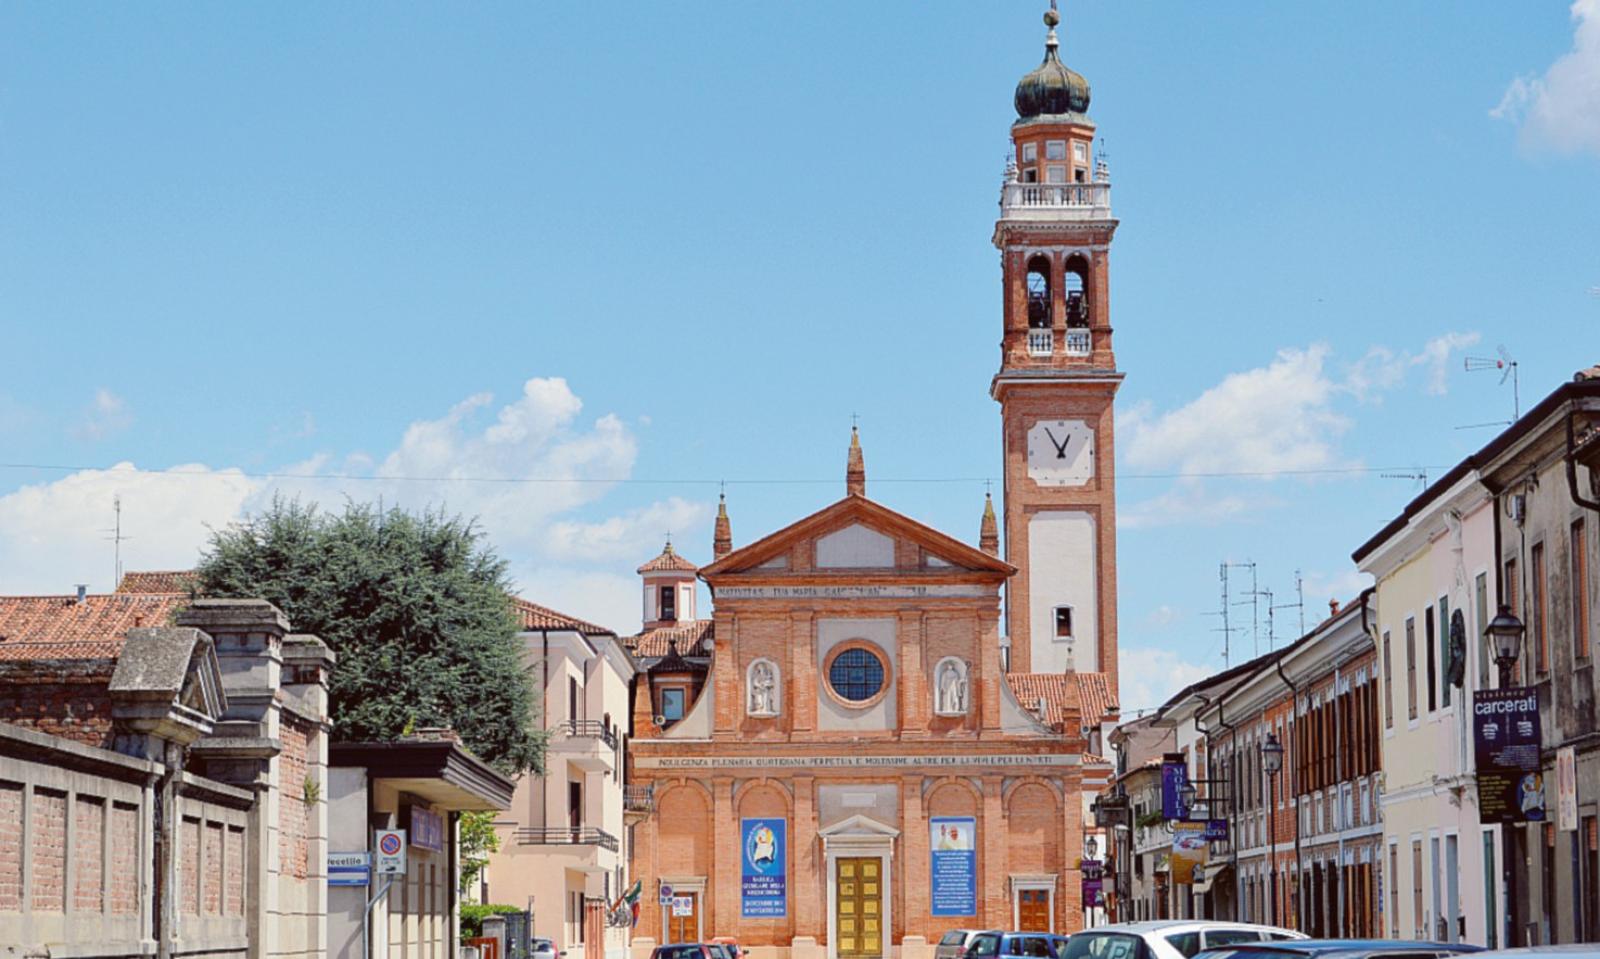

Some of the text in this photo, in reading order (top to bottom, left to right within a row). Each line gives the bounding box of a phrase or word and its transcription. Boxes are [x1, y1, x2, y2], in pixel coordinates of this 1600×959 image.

[1475, 690, 1525, 699] visitare
[1474, 696, 1537, 715] carcerati
[711, 758, 752, 766] PLENARIA
[1173, 767, 1183, 817] MOBILI
